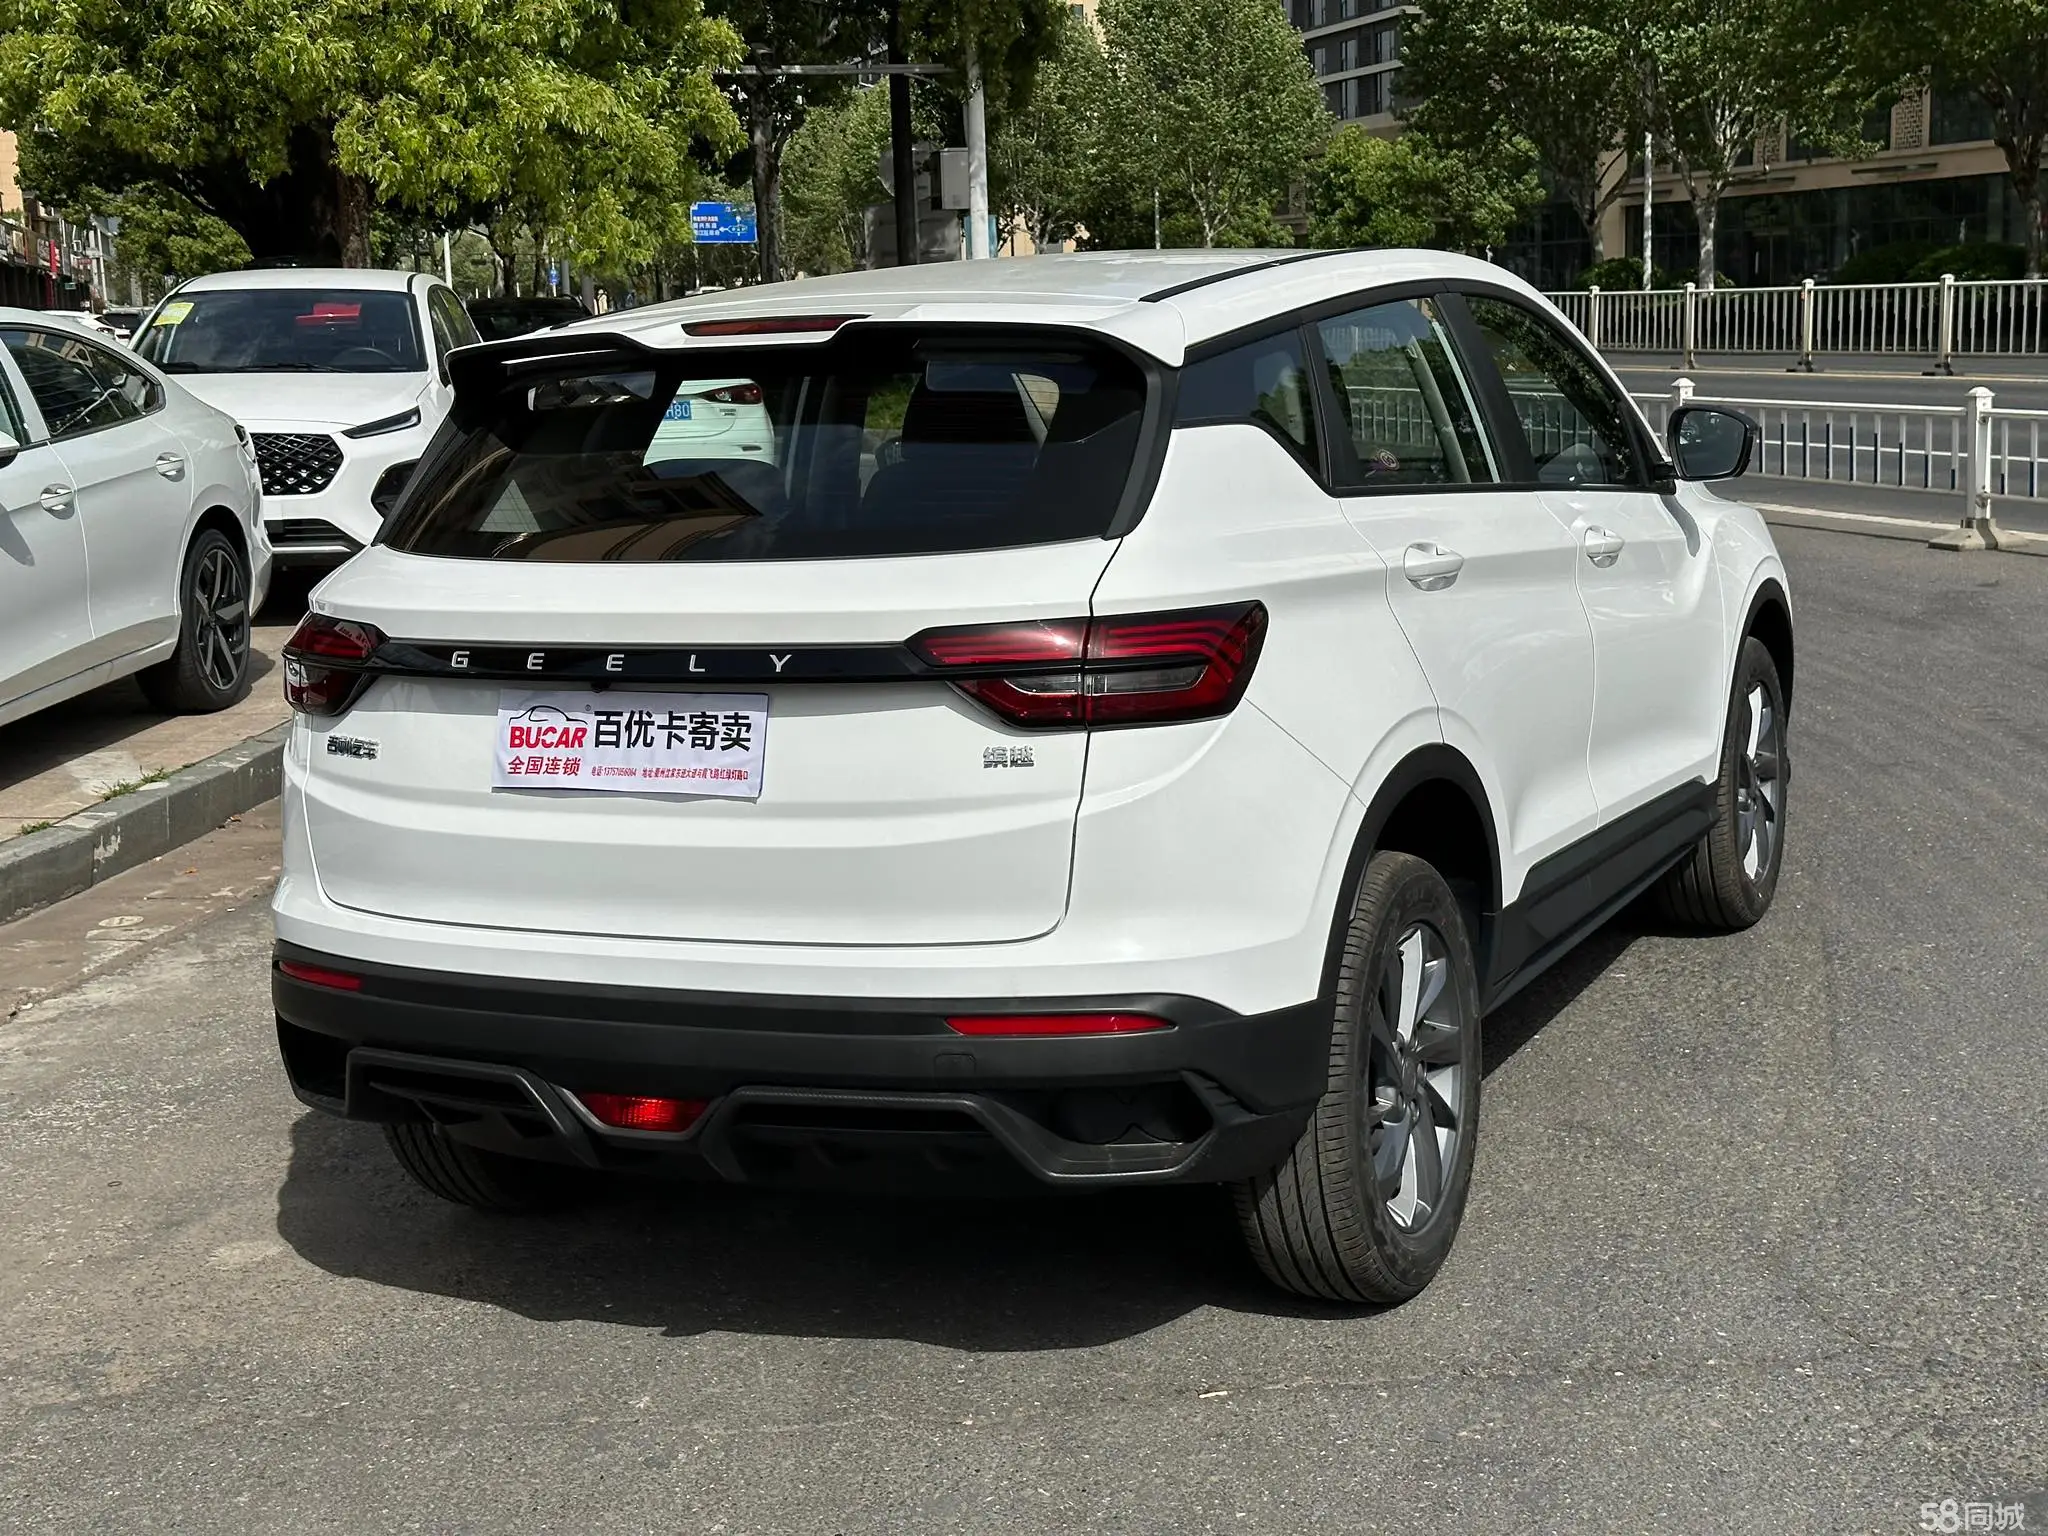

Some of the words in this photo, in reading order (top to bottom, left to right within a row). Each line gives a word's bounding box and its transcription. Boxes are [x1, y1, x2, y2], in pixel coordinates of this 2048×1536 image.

[451, 651, 792, 673] GEELY
[509, 726, 588, 749] BUCAR
[594, 710, 752, 752] 百优卡寄卖
[507, 755, 582, 776] 全国连锁
